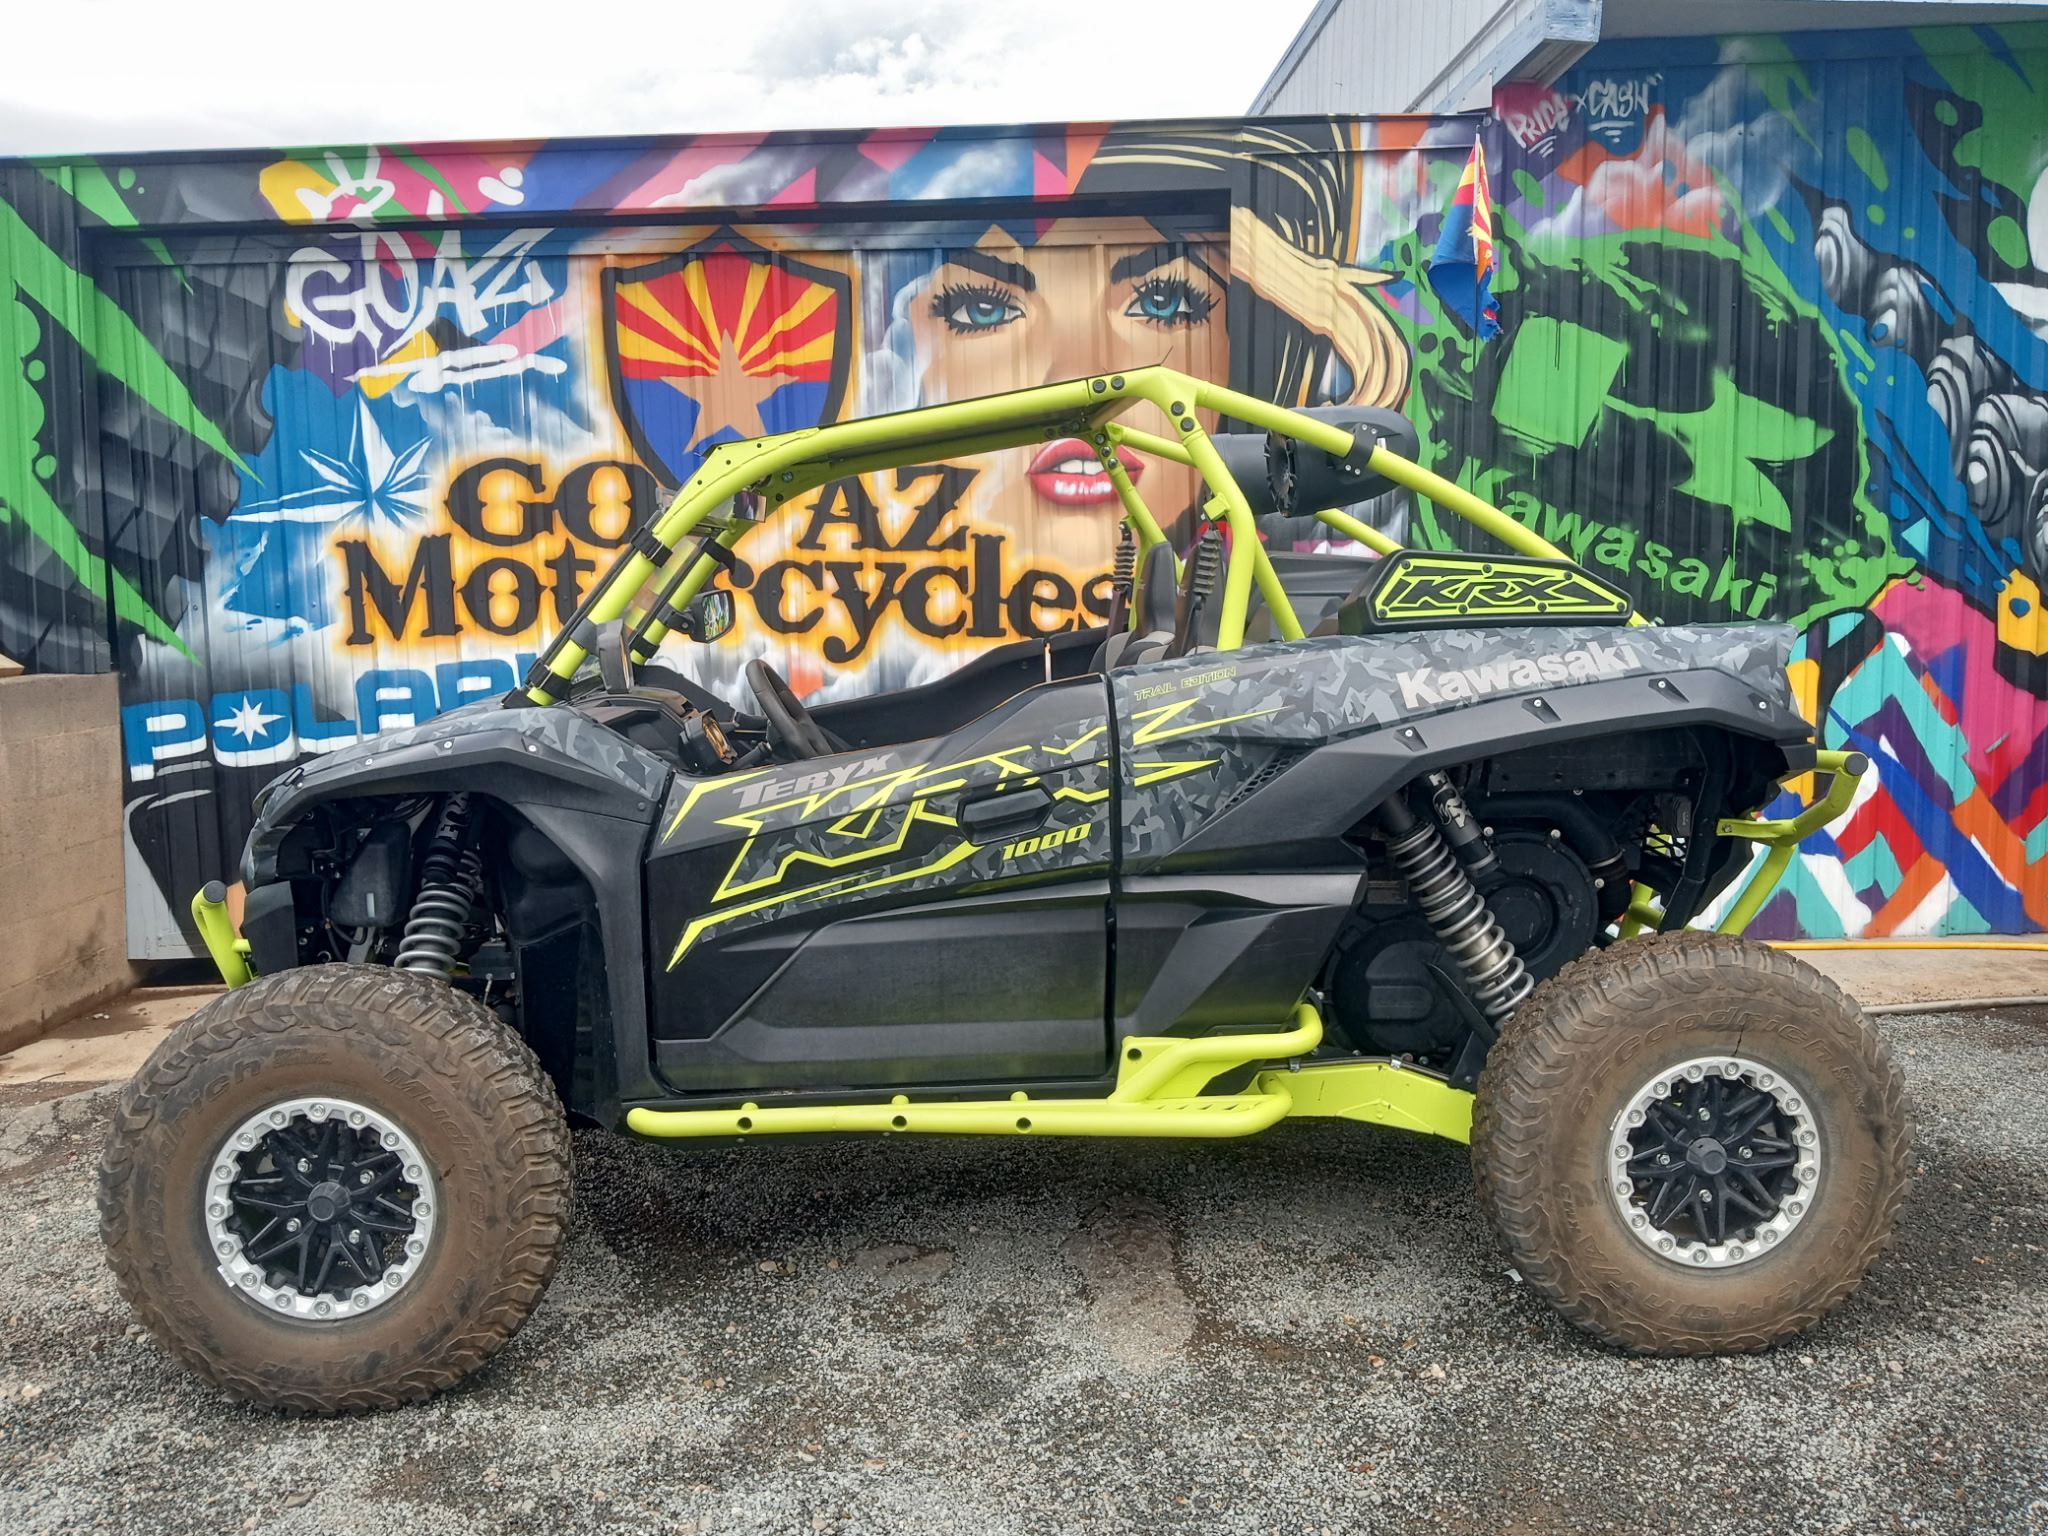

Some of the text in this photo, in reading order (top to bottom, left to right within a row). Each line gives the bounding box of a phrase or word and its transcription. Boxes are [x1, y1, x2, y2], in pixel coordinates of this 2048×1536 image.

[447, 458, 980, 552] GO AZ
[1446, 455, 1778, 620] Kawasaki
[337, 533, 1131, 663] Motrcycles
[1390, 572, 1590, 608] KRX
[1134, 666, 1237, 701] TRAIL EDITION
[1396, 641, 1643, 709] Kawasaki
[732, 753, 896, 810] TERYX
[1002, 822, 1092, 861] 1000
